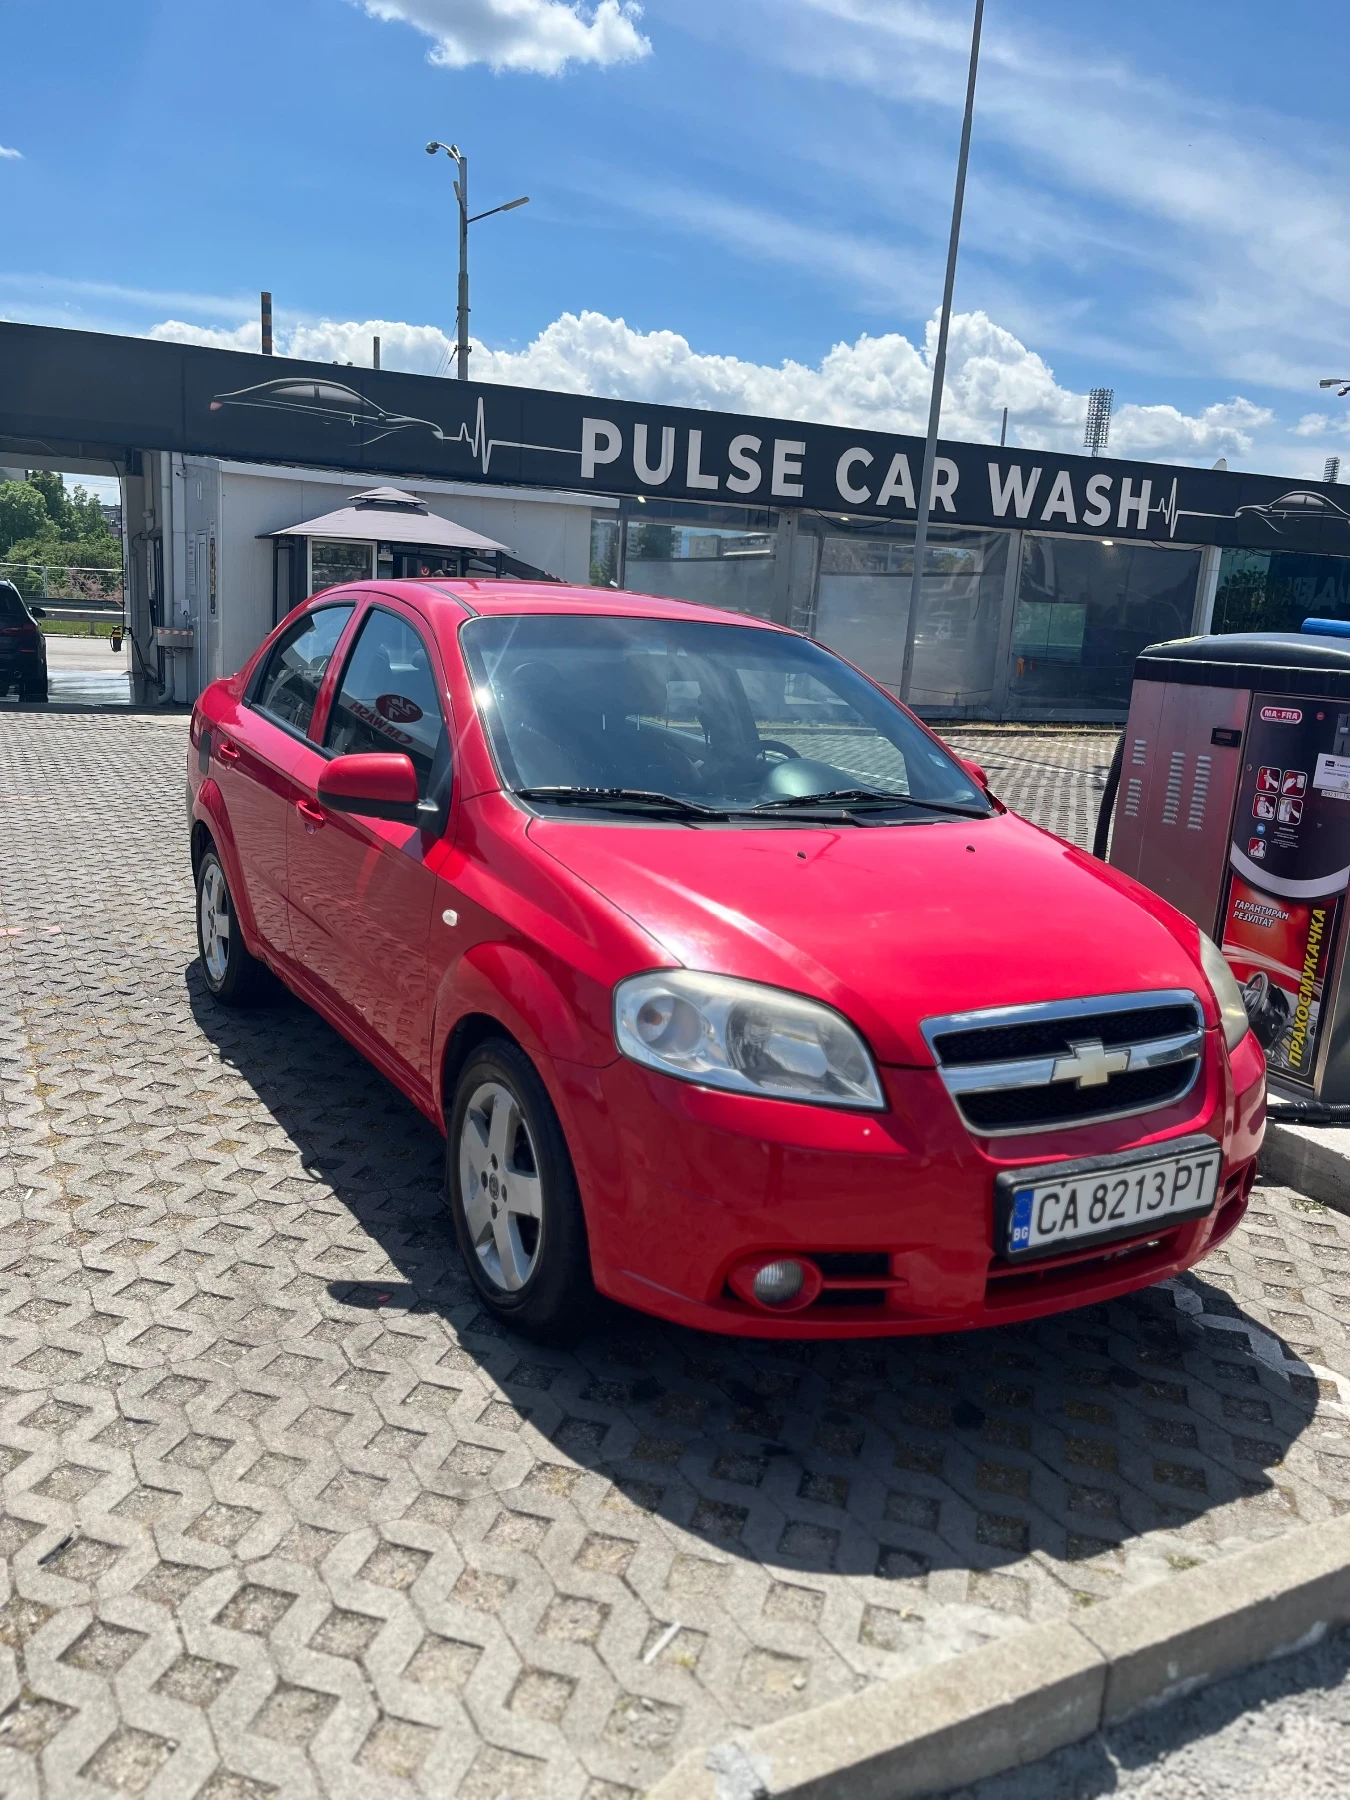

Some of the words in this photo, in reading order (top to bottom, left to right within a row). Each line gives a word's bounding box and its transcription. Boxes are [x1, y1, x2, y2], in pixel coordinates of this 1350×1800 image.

[580, 417, 805, 498] PULSE
[836, 446, 960, 513] CAR
[988, 462, 1153, 530] WASH
[1233, 911, 1275, 928] РЕЗУЛТАТ
[1234, 899, 1290, 921] ГАРАНТИРАН
[1288, 908, 1327, 1068] ПРАХОСМУКАЧКА
[1012, 1226, 1029, 1242] BG
